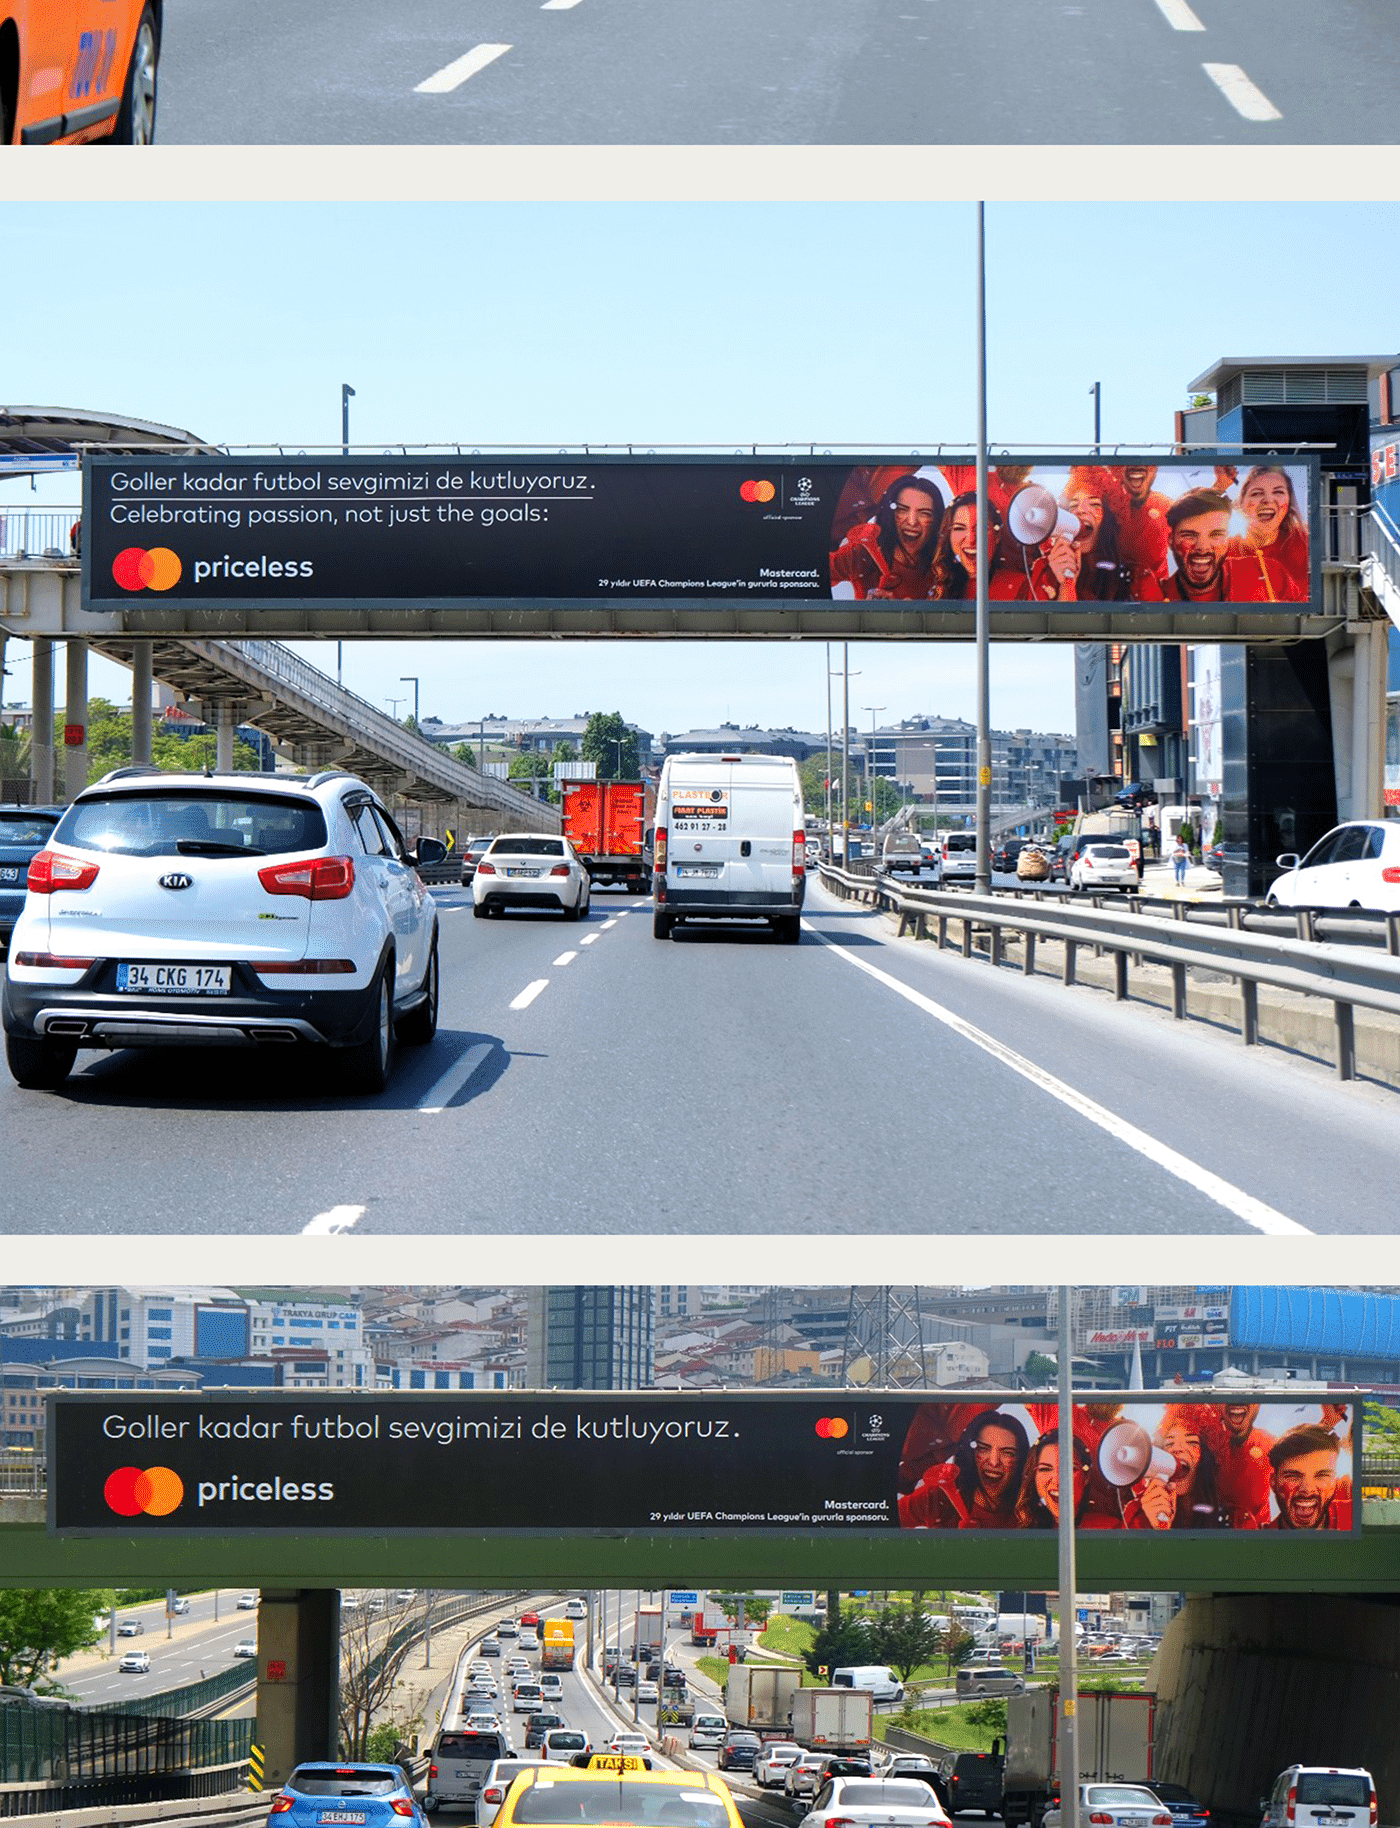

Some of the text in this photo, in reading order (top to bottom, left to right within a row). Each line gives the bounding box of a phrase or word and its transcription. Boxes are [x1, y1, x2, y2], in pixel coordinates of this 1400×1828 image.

[110, 470, 596, 495] Goller kadar futbol sevgimizi de kutluyoruz.
[110, 503, 549, 527] Celebrating passion, not just the goals:
[194, 553, 313, 582] priceless
[759, 568, 820, 578] Mastercard.
[598, 579, 608, 588] 29
[610, 579, 631, 590] yıldır
[633, 580, 657, 588] UEFA
[658, 580, 704, 590] Champions
[747, 580, 777, 591] gururla
[779, 581, 820, 591] sponsoru.
[675, 822, 688, 830] 462
[690, 822, 699, 830] 91
[718, 823, 727, 831] 28
[164, 876, 188, 887] KIA
[129, 967, 224, 987] 34 CKG 174
[283, 1310, 314, 1318] TRAKYA
[103, 1414, 740, 1444] Goller kadar futbol sevgimizi de kutluyoruz.
[198, 1475, 334, 1507] priceless
[824, 1499, 889, 1510] Mastercard.
[650, 1512, 661, 1521] 29
[663, 1511, 685, 1523] yıldır
[687, 1512, 712, 1521] UEFA
[715, 1512, 764, 1523] Champions
[811, 1512, 843, 1523] gururla
[845, 1513, 889, 1524] sponsoru.
[322, 1813, 332, 1821] 34
